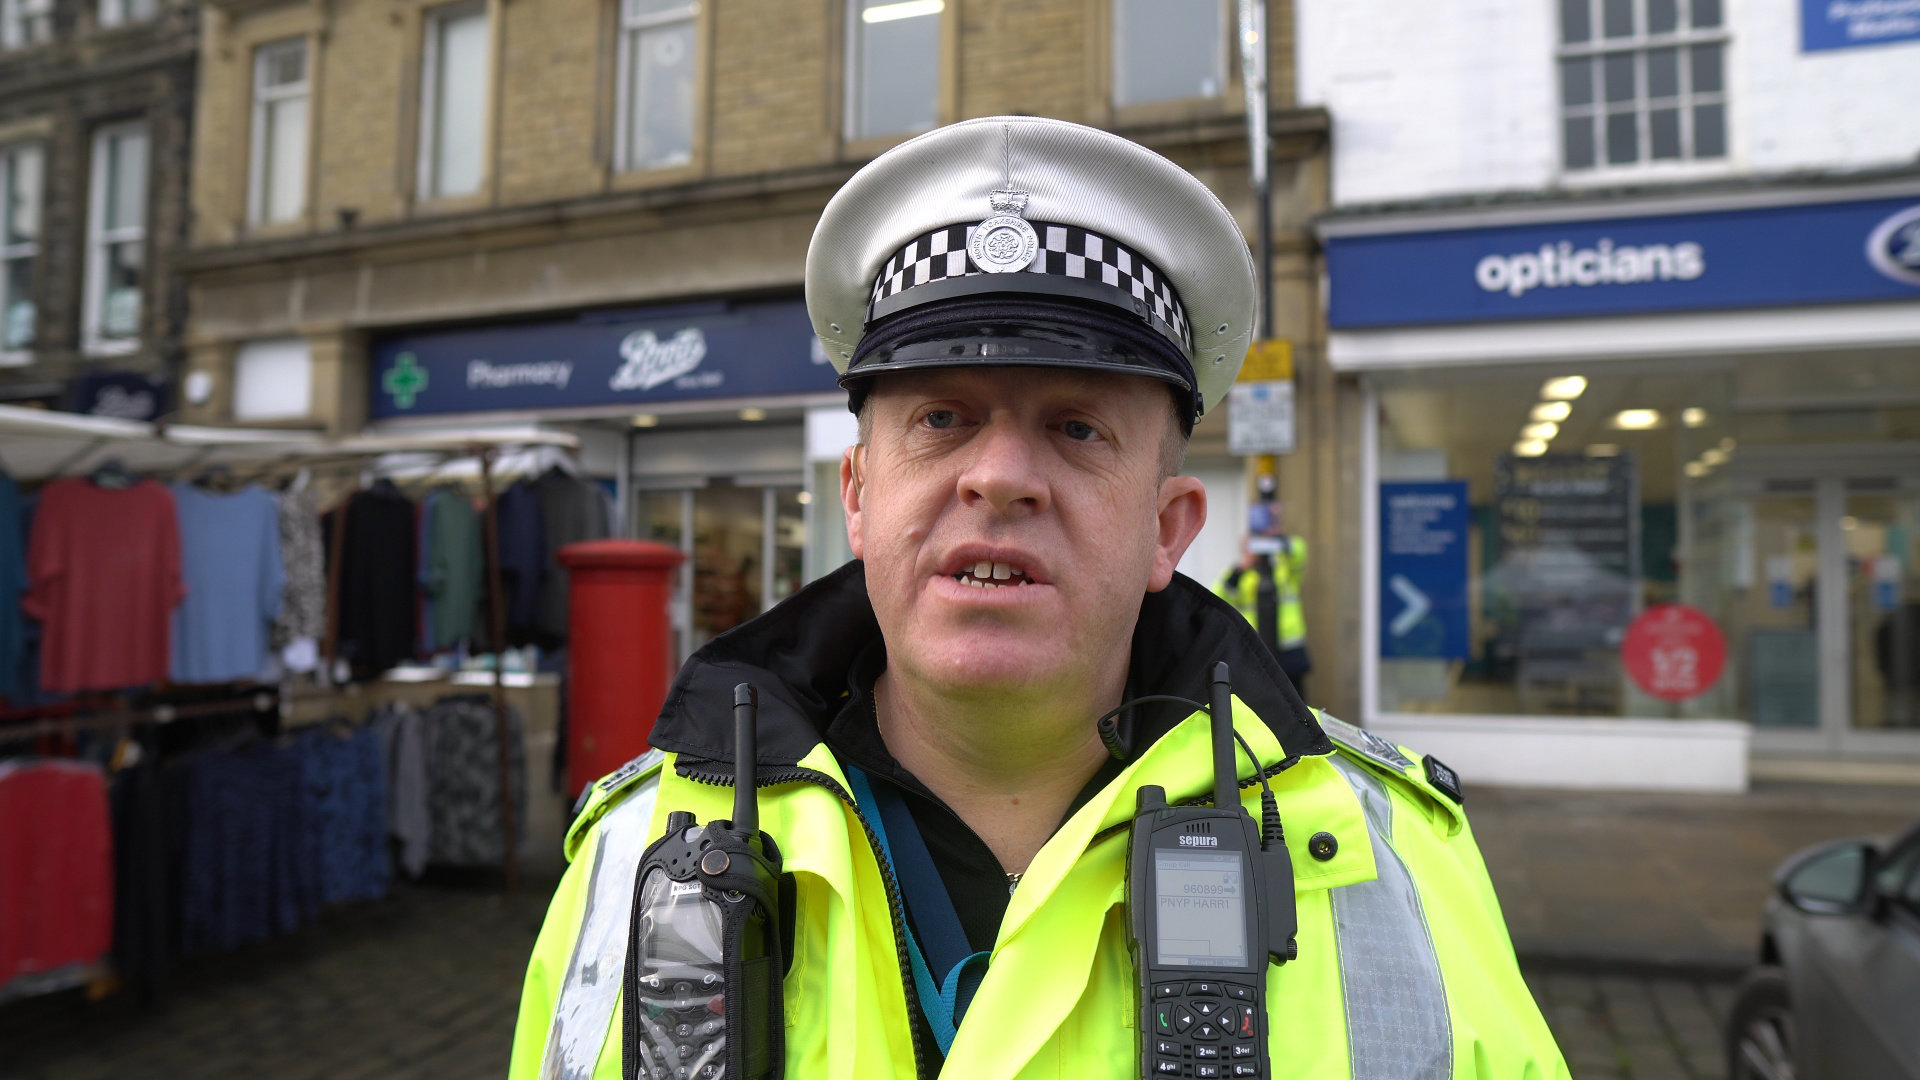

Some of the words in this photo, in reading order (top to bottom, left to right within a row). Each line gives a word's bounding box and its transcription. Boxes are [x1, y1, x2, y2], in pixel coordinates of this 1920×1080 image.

[973, 233, 982, 260] NORTH
[982, 218, 1029, 232] YORKSHIRE
[1020, 235, 1035, 262] POLICE
[1475, 237, 1706, 298] opticians
[466, 359, 573, 390] Pharmacy
[1179, 835, 1218, 847] sepura
[1183, 884, 1224, 894] 960899
[1160, 897, 1190, 908] PNYP
